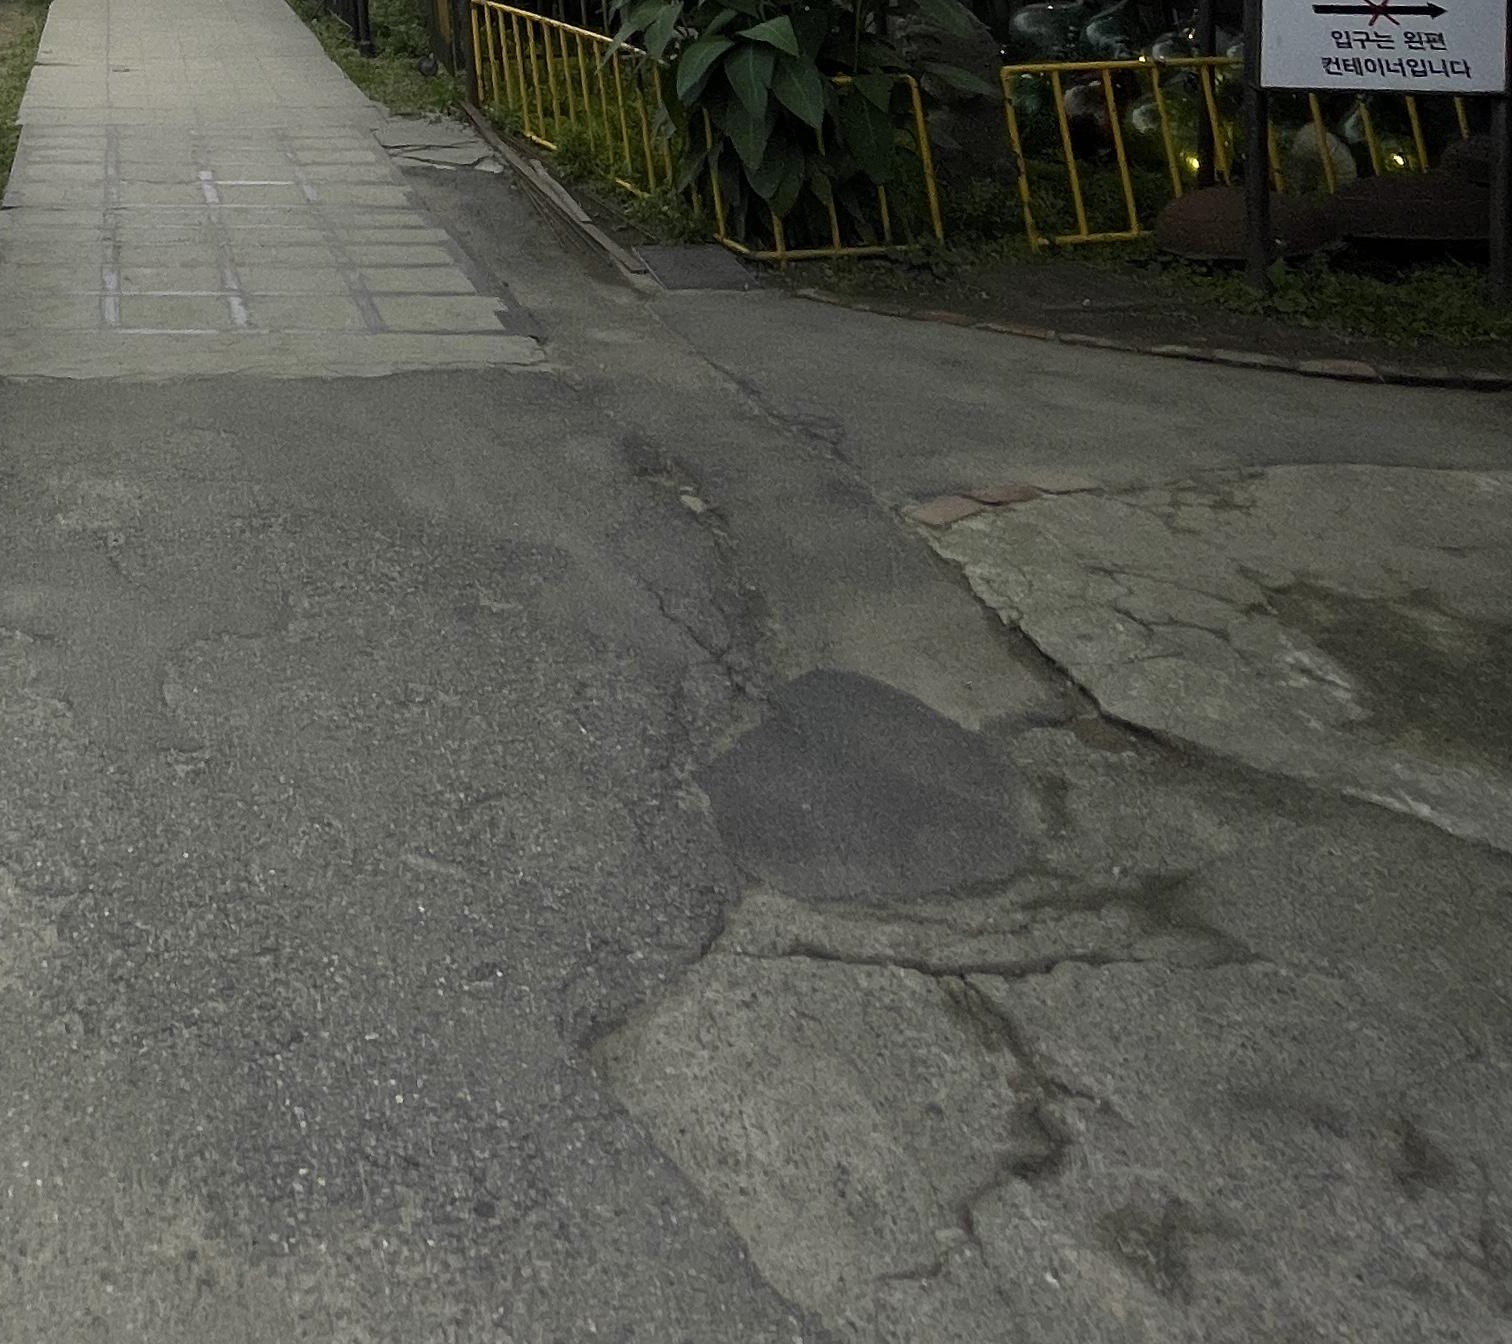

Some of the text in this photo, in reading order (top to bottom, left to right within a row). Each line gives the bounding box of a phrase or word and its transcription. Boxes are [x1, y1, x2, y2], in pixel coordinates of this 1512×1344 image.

[1331, 30, 1448, 51] 입구는 왼편
[1321, 57, 1472, 79] 컨테이너입니다
